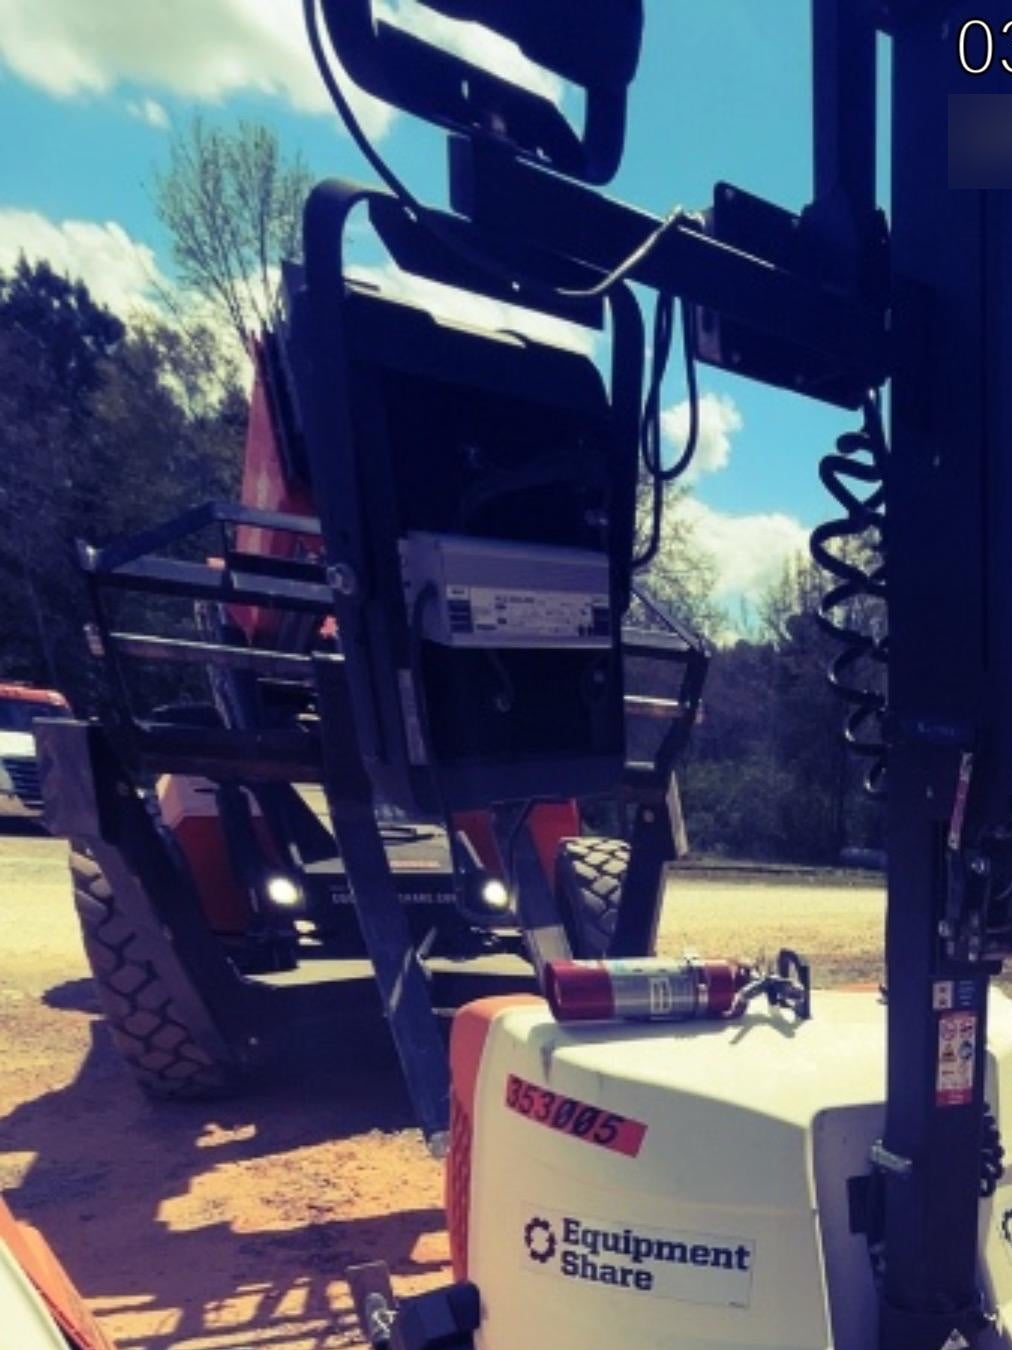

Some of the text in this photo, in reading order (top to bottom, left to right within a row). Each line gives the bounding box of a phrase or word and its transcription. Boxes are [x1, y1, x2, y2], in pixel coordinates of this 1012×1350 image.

[507, 1075, 625, 1145] 353005
[560, 1250, 654, 1291] Share
[562, 1217, 750, 1271] Equipment
